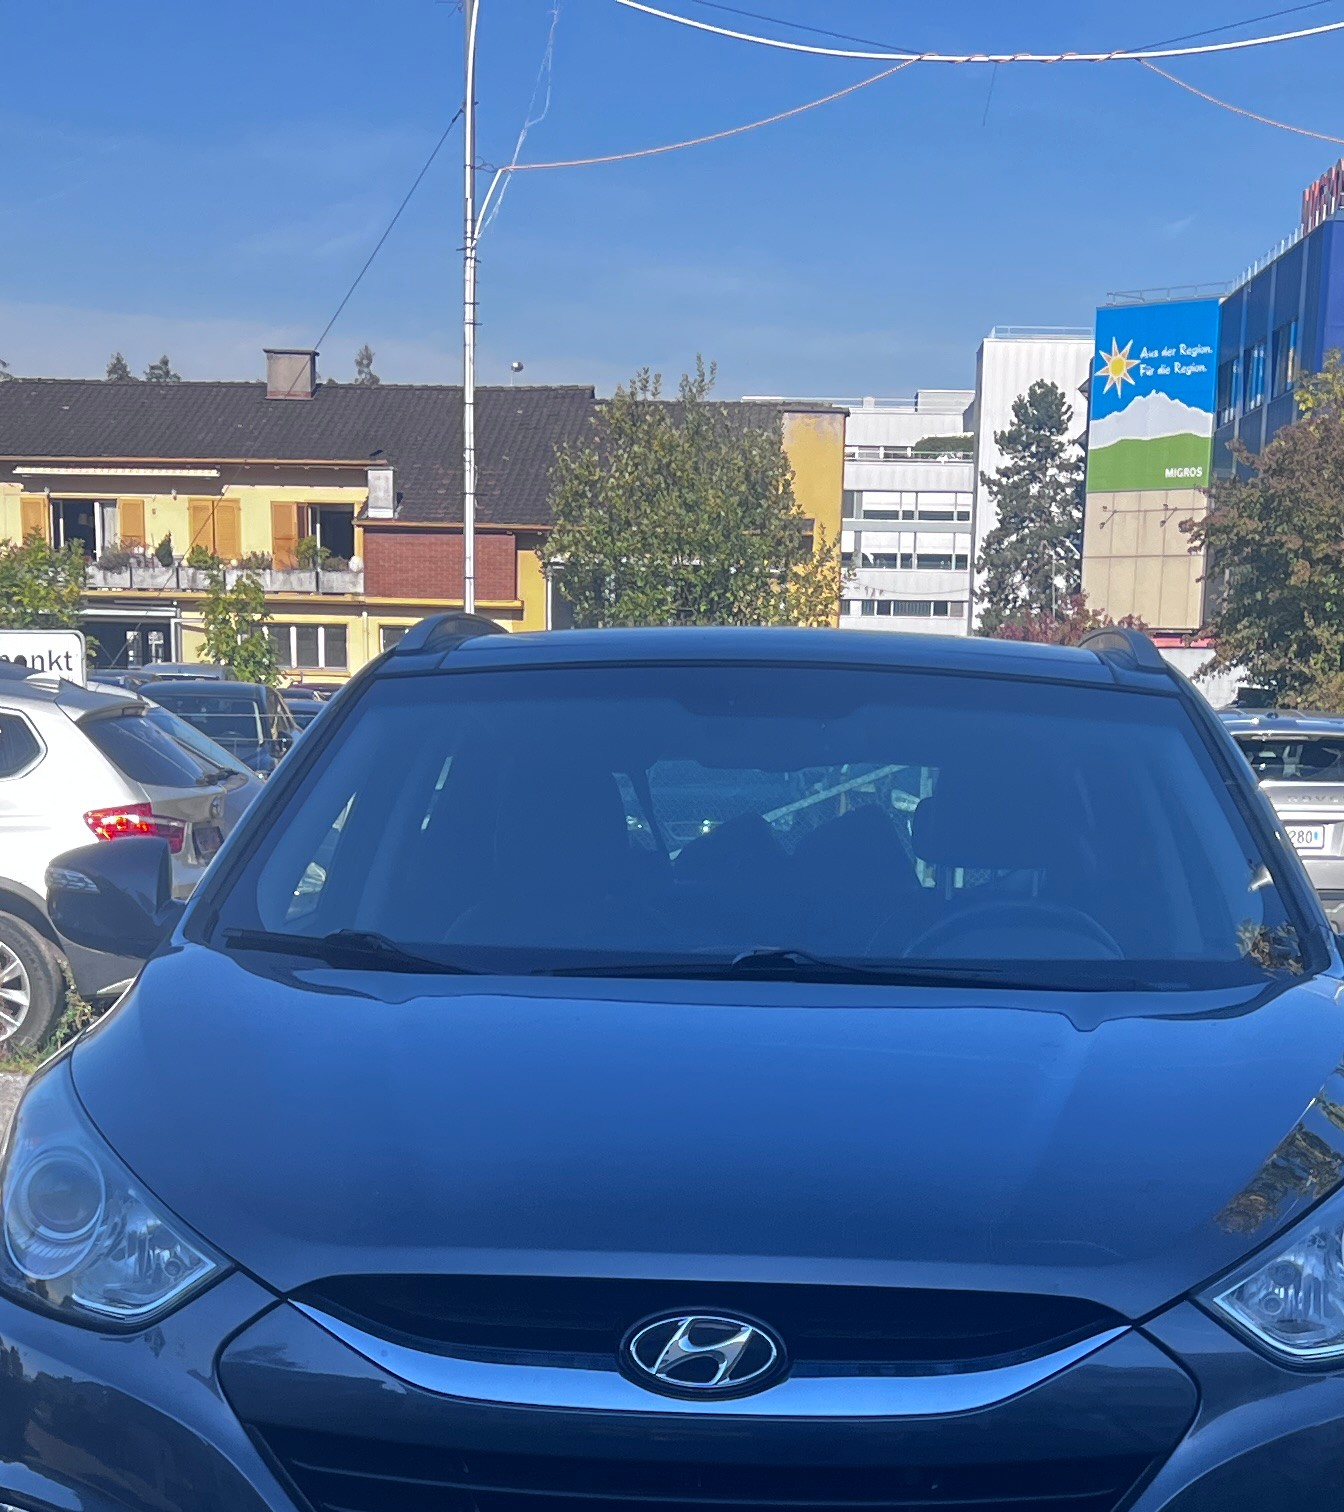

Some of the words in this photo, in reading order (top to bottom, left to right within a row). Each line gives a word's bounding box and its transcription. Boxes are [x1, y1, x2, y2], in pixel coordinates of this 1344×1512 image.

[1140, 346, 1158, 359] Aus
[1161, 345, 1176, 357] der
[1179, 343, 1213, 357] Region.
[1140, 363, 1154, 377] Für
[1157, 363, 1171, 375] die
[1174, 361, 1207, 375] Region.
[1165, 466, 1203, 478] MIGROS
